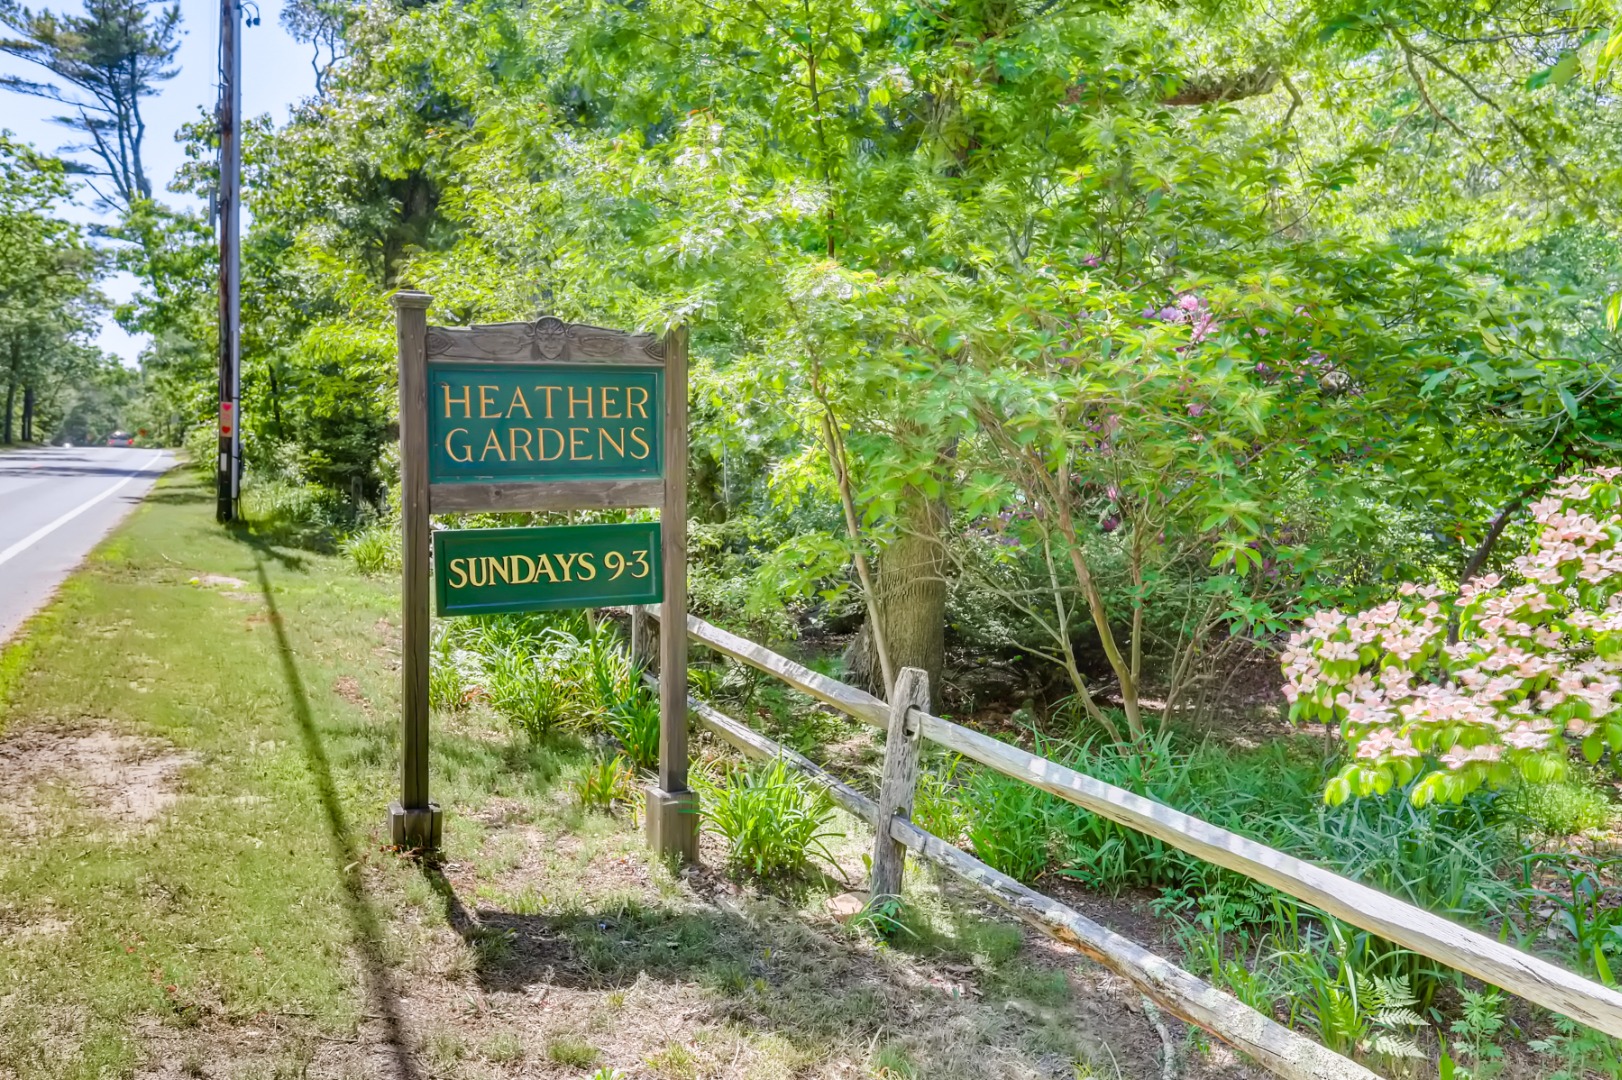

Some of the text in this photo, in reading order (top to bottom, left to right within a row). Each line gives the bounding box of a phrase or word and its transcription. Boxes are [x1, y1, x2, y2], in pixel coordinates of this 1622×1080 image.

[441, 385, 649, 419] HEATHER
[444, 427, 650, 462] GARDENS
[448, 550, 650, 589] SUNDAYS 9-3
